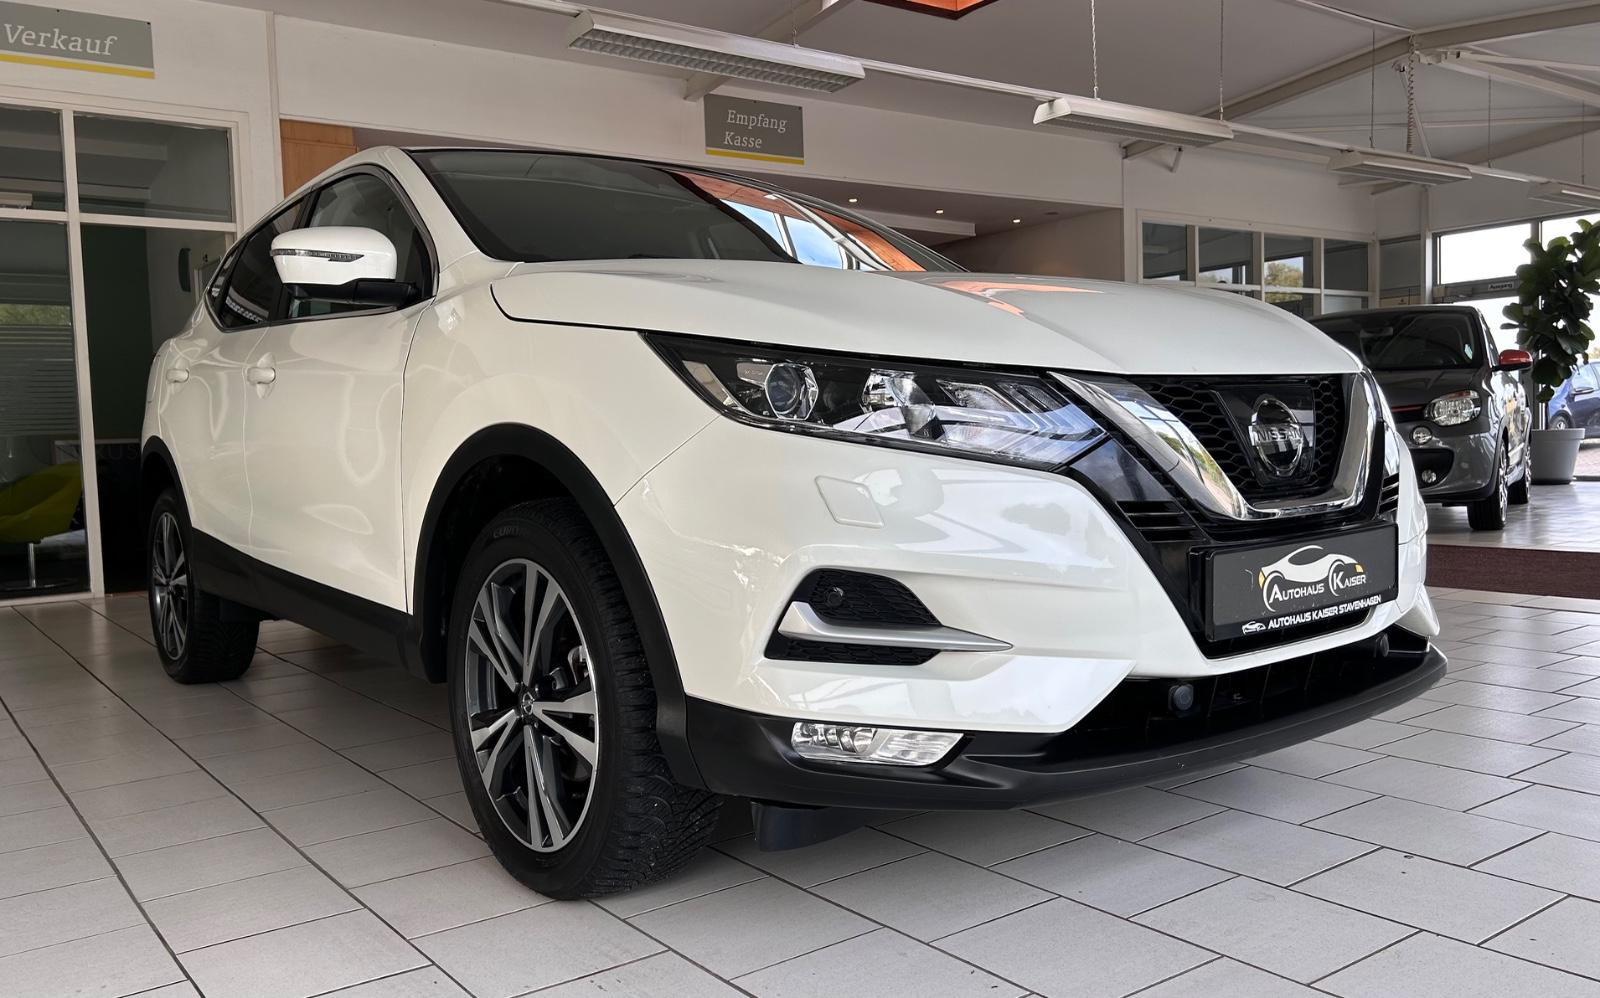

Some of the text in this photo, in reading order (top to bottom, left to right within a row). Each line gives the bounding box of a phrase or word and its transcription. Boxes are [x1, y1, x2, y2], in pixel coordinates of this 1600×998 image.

[4, 23, 118, 56] Verkauf
[727, 109, 787, 133] Empfang
[724, 131, 762, 148] Kasse
[1257, 426, 1301, 442] NISSAN
[1269, 595, 1381, 629] AUTOHAUS KAISER STAVENHAGEN
